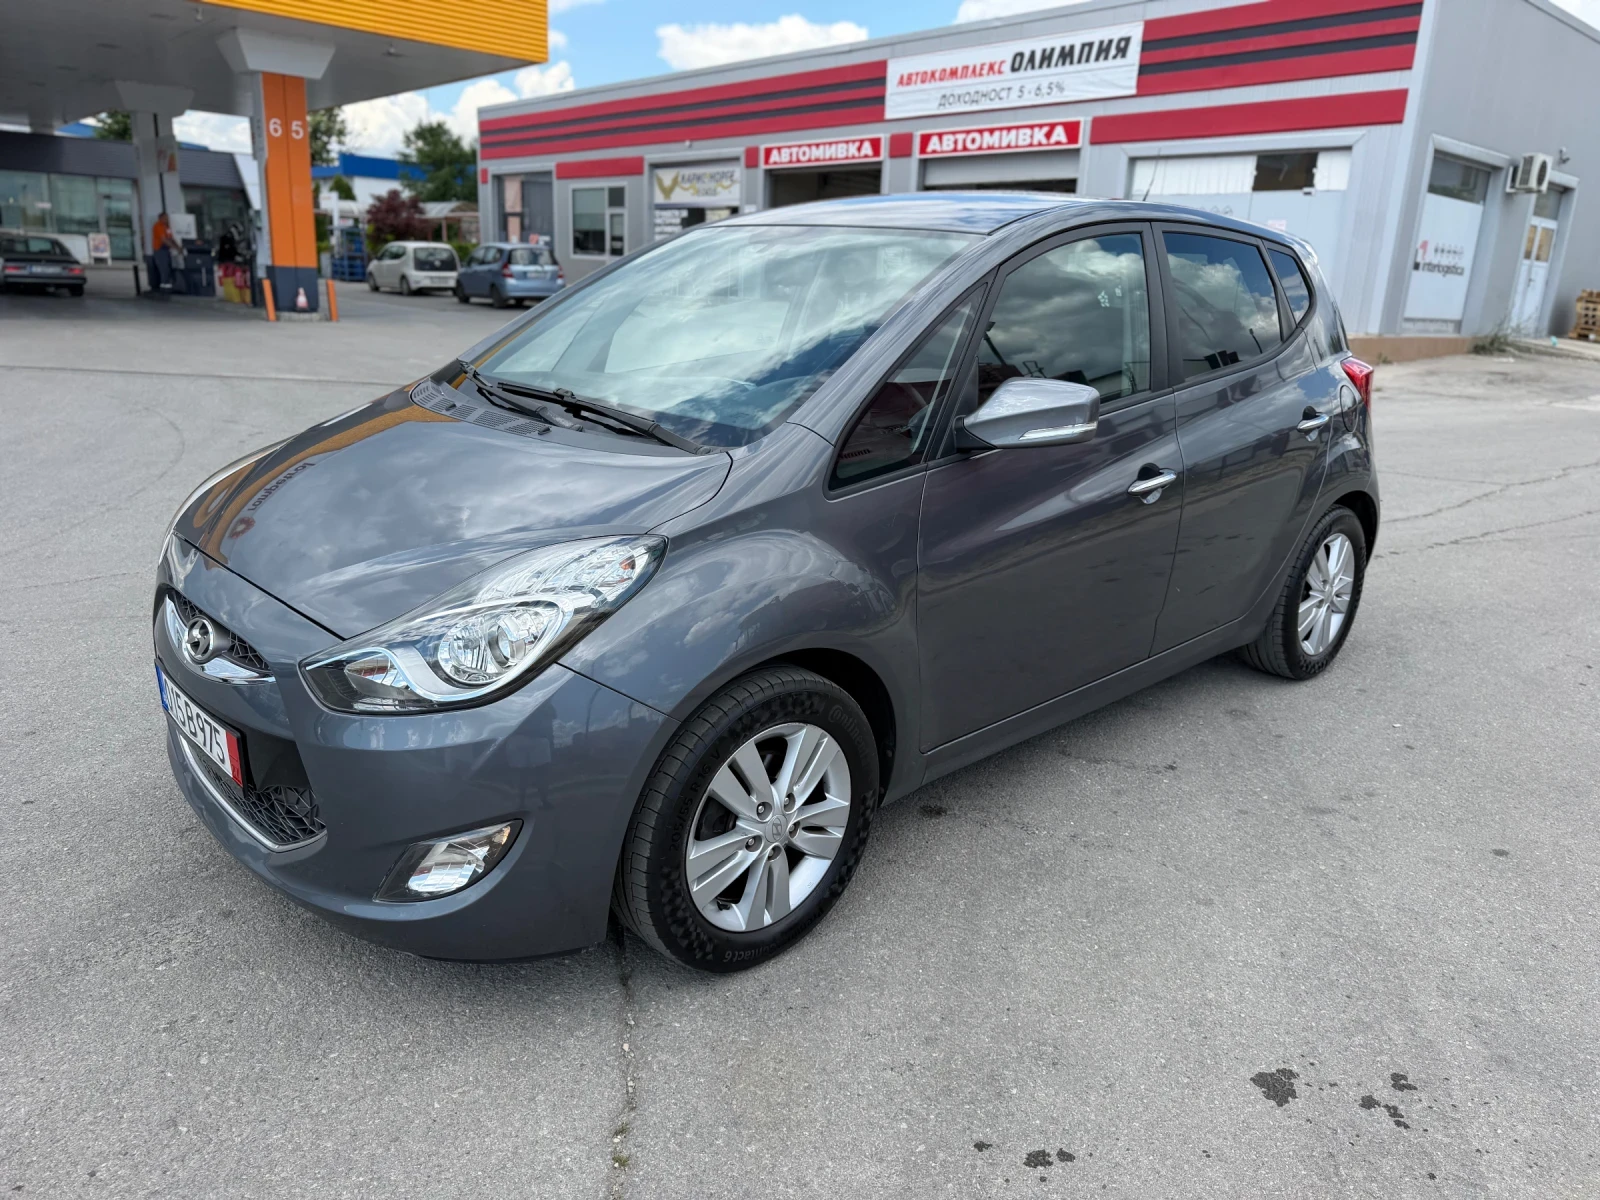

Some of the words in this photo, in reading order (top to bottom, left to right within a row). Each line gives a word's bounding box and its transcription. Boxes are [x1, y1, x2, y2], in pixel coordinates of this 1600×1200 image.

[897, 60, 1006, 87] АВТОКОМПЛЕКС
[1010, 36, 1132, 73] ОЛИМПИЯ
[937, 87, 1012, 109] ДОХОДНОСТ
[1017, 85, 1025, 99] 5
[1035, 80, 1065, 99] 6,5%
[269, 118, 282, 137] 6
[291, 120, 304, 139] 5
[925, 124, 1068, 153] АВТОМИВКА
[768, 140, 874, 164] АВТОМИВКА
[668, 798, 693, 852] 205/55
[689, 782, 702, 793] R
[698, 764, 711, 778] 16
